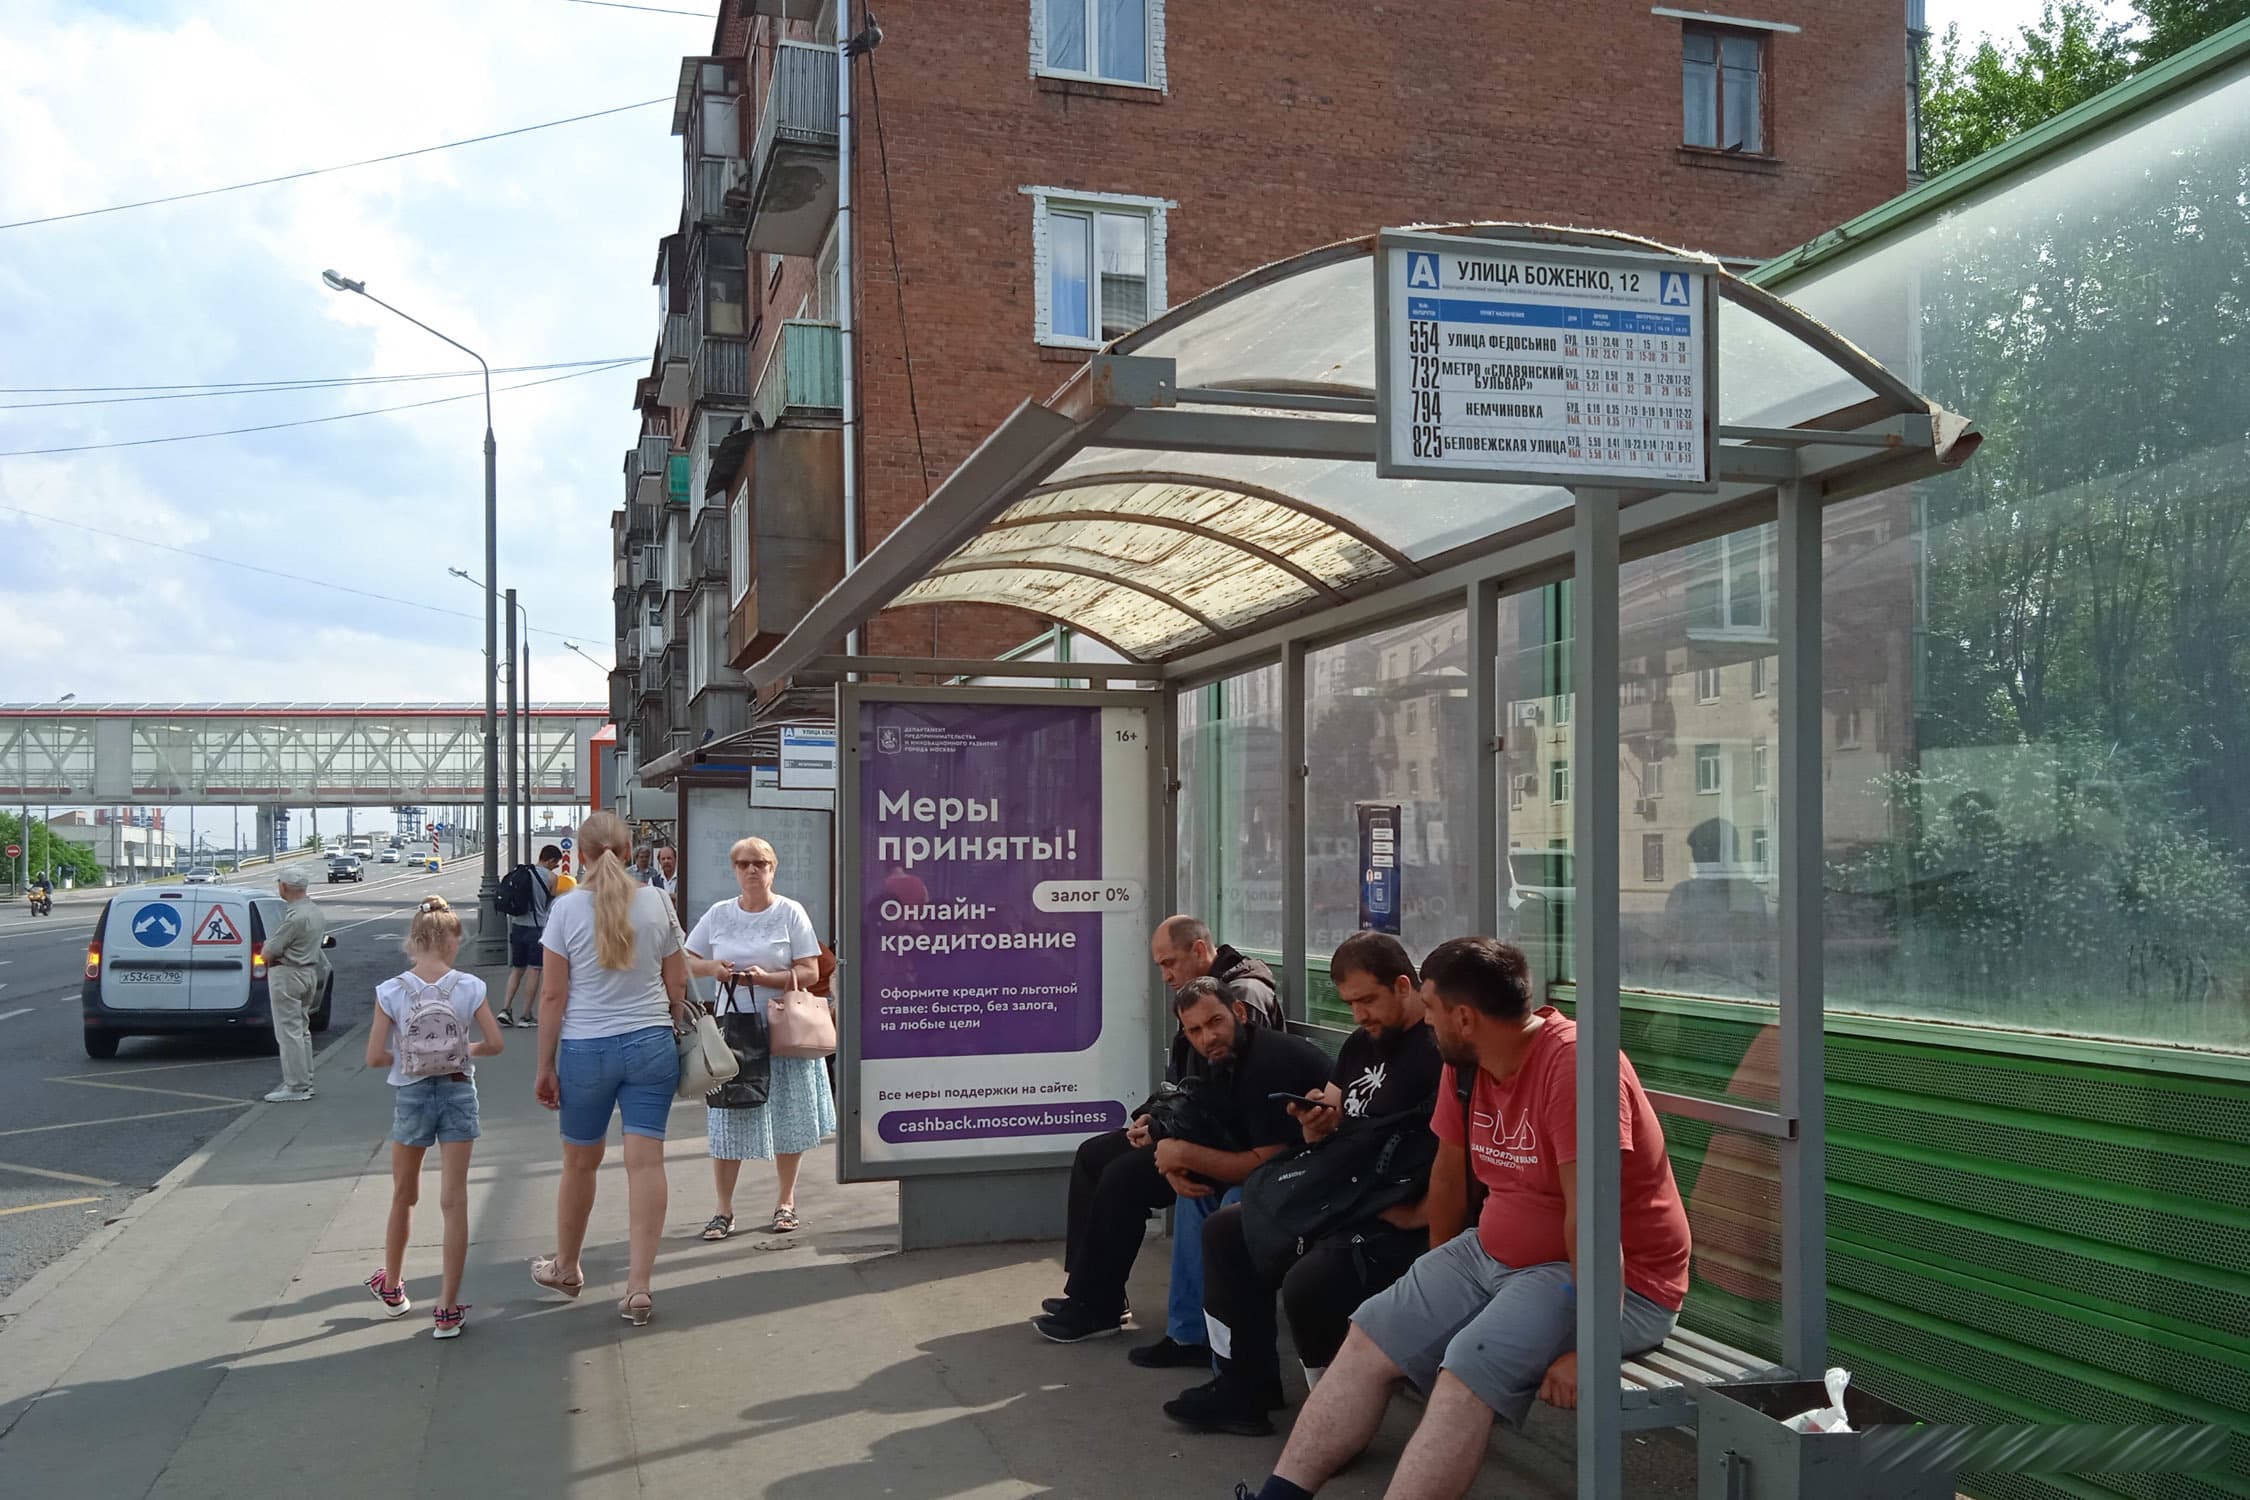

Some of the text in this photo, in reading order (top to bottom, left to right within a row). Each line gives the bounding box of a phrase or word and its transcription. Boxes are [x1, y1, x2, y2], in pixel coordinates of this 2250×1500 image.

[1410, 255, 1437, 287] А
[1457, 261, 1639, 293] УЛИЦА БОЖЕНКО, 12
[1663, 274, 1687, 304] А
[1410, 321, 1439, 354] 554
[1448, 333, 1556, 351] УЛИЦА ФЕДОСЬИНО
[1410, 356, 1440, 389] 732
[1442, 361, 1564, 380] МЕТРО «СЛАВЯНСКИЙ
[1475, 376, 1533, 390] БУЛЬВАР»
[1411, 391, 1441, 423] 794
[1466, 402, 1543, 418] НЕМЧИНОВКА
[1413, 425, 1442, 458] 825
[1444, 436, 1567, 455] БЕЛОВЕЖСКАЯ УЛИЦА
[1116, 730, 1138, 742] 16+
[879, 790, 998, 829] Меры
[879, 830, 1077, 868] приняты!
[1051, 888, 1130, 902] залог 0%
[880, 897, 996, 920] Онлайн-
[881, 932, 1076, 956] кредитование
[880, 983, 1078, 1000] Оформите кредит по льготной
[881, 1000, 1057, 1016] ставке: быстро, без залога,
[881, 1018, 980, 1032] на любые цели
[879, 1082, 1078, 1102] Все меры поддержки на сайте:
[899, 1109, 1107, 1133] cashback.moscow.business
